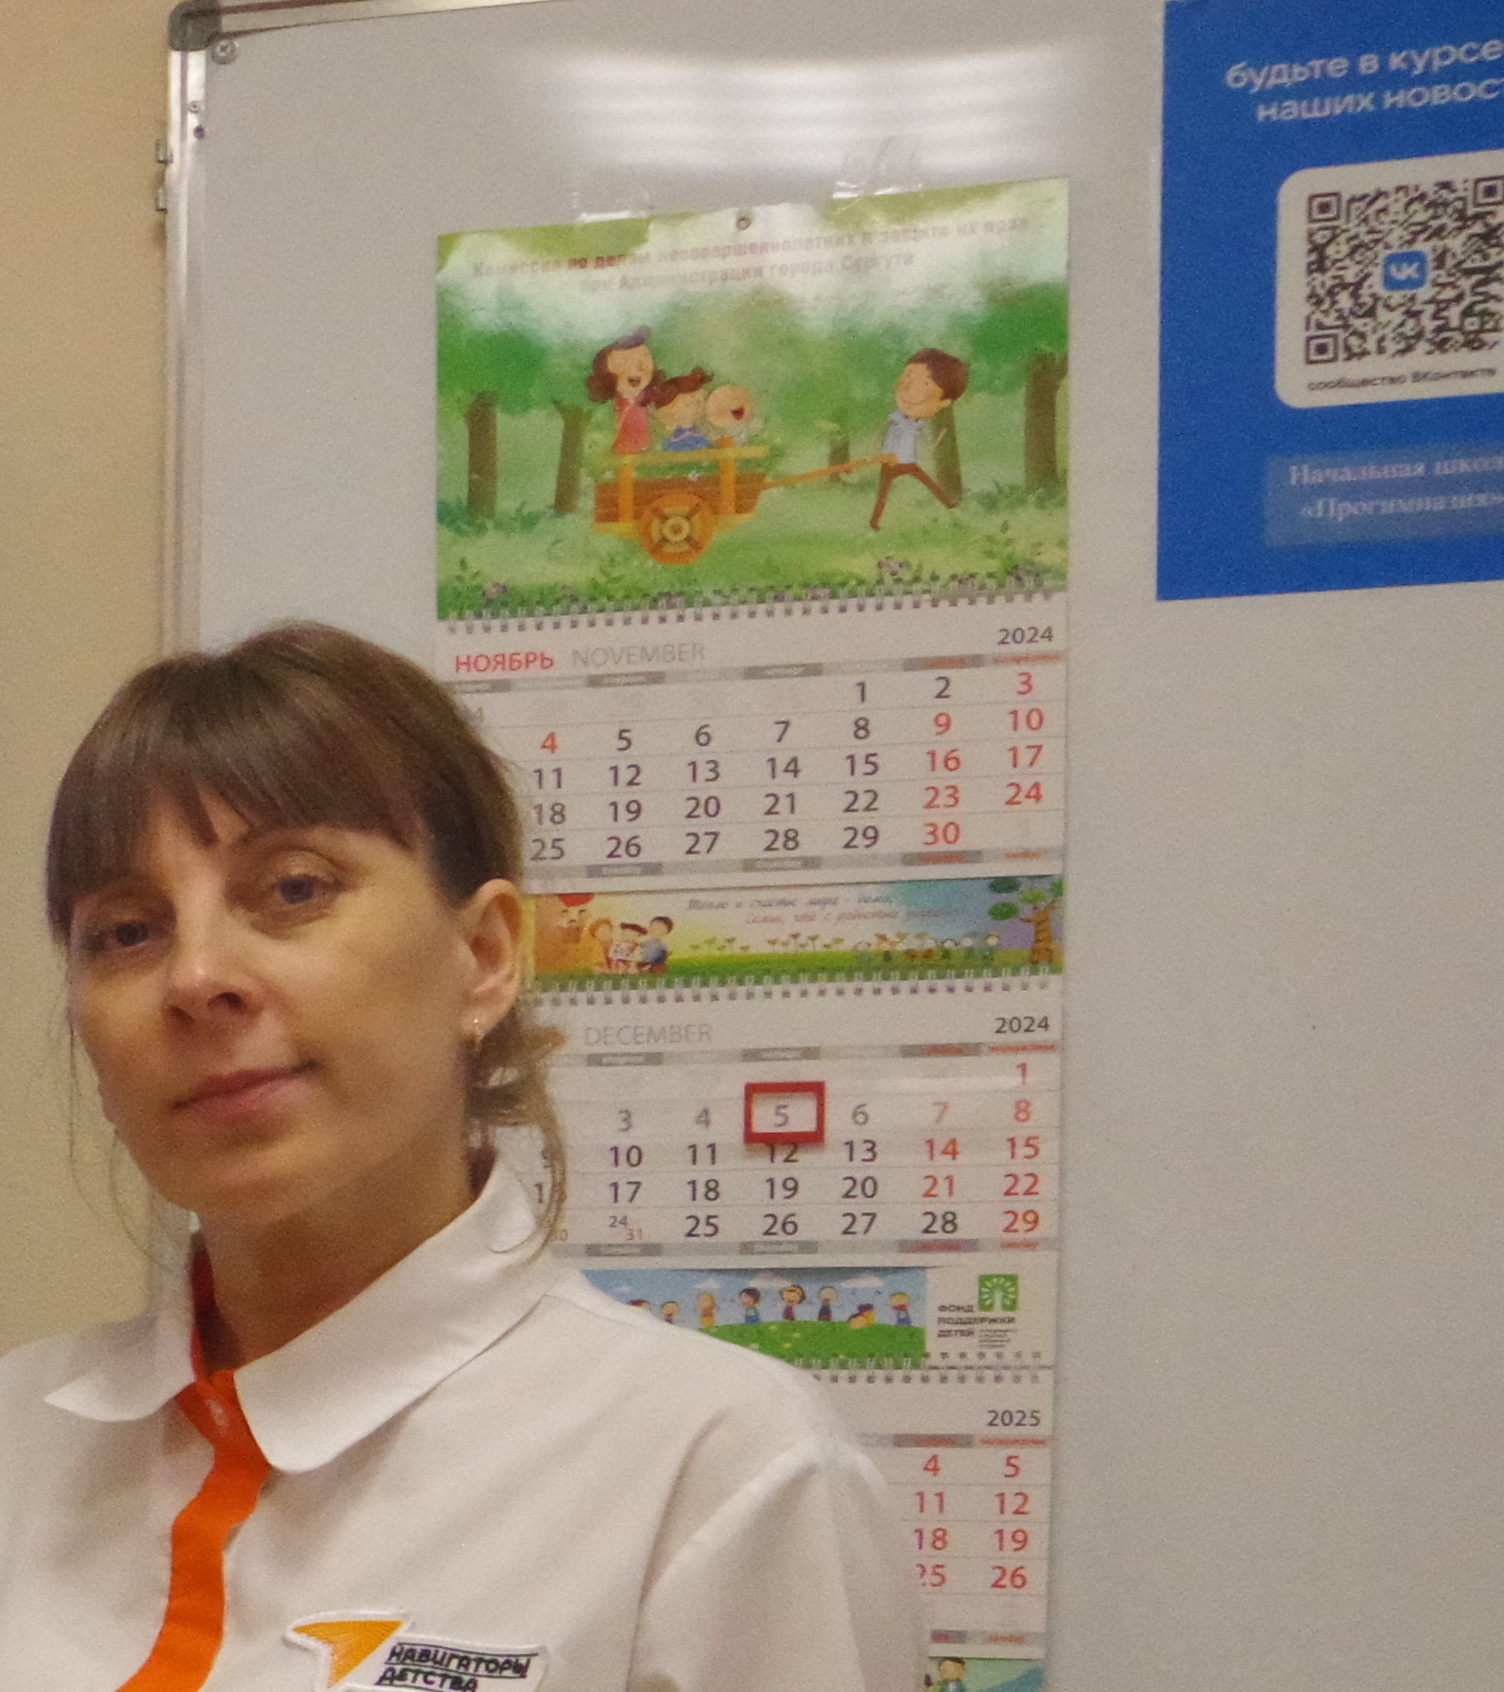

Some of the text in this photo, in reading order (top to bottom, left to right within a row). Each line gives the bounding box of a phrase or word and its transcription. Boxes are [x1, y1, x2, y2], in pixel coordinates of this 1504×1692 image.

[1226, 39, 1504, 93] будьте в курсе
[1256, 78, 1504, 122] наших новос
[997, 626, 1054, 646] 2024
[455, 651, 555, 674] НОЯБРЬ
[571, 643, 706, 667] NOVEMBER
[854, 671, 1033, 703] 1 2 3
[540, 707, 1044, 754] 4 5 6 7 8 9 10
[533, 744, 1044, 789] 11 12 13 14 15 16 17
[533, 781, 1044, 825] 18 19 20 21 22 23 24
[530, 821, 961, 861] 25 26 27 28 29 30
[584, 1023, 711, 1046] DECEMBER
[994, 1016, 1050, 1034] 2024
[1016, 1062, 1028, 1086] 1
[618, 1099, 1031, 1132] 3 4 5 6 7 8
[609, 1135, 1040, 1168] 10 11 12 13 14 15
[609, 1172, 1040, 1203] 17 18 19 20 21 22
[608, 1209, 1039, 1238] 24 25 26 27 28 29
[987, 1409, 1041, 1427] 2025
[923, 1454, 1020, 1478] 4 5
[914, 1491, 1030, 1515] 11 12
[914, 1527, 1029, 1551] 18 19
[990, 1565, 1027, 1589] 26
[387, 1645, 531, 1678] НАВИГАТОРЫ
